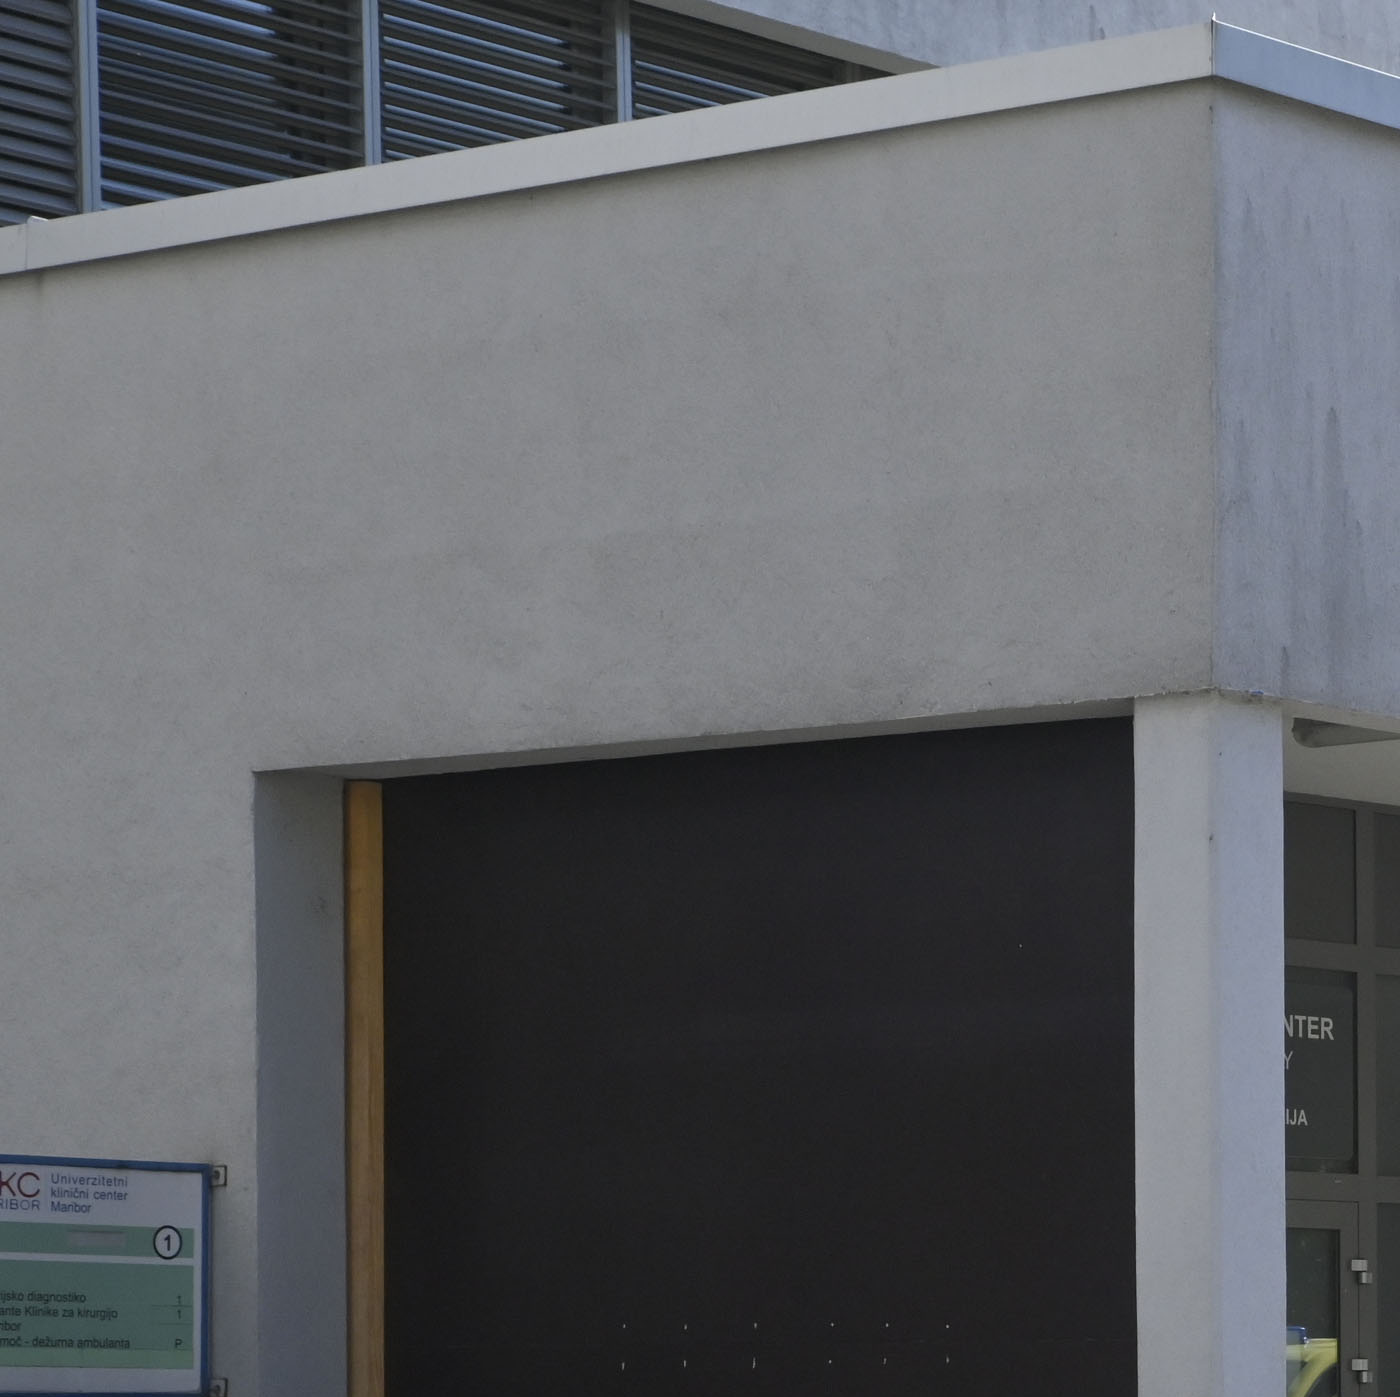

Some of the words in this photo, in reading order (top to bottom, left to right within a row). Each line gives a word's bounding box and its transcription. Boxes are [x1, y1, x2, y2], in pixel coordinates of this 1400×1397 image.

[51, 1172, 128, 1188] Univerzitetni
[51, 1186, 89, 1199] klinični
[93, 1190, 128, 1201] center
[163, 1235, 171, 1252] 1
